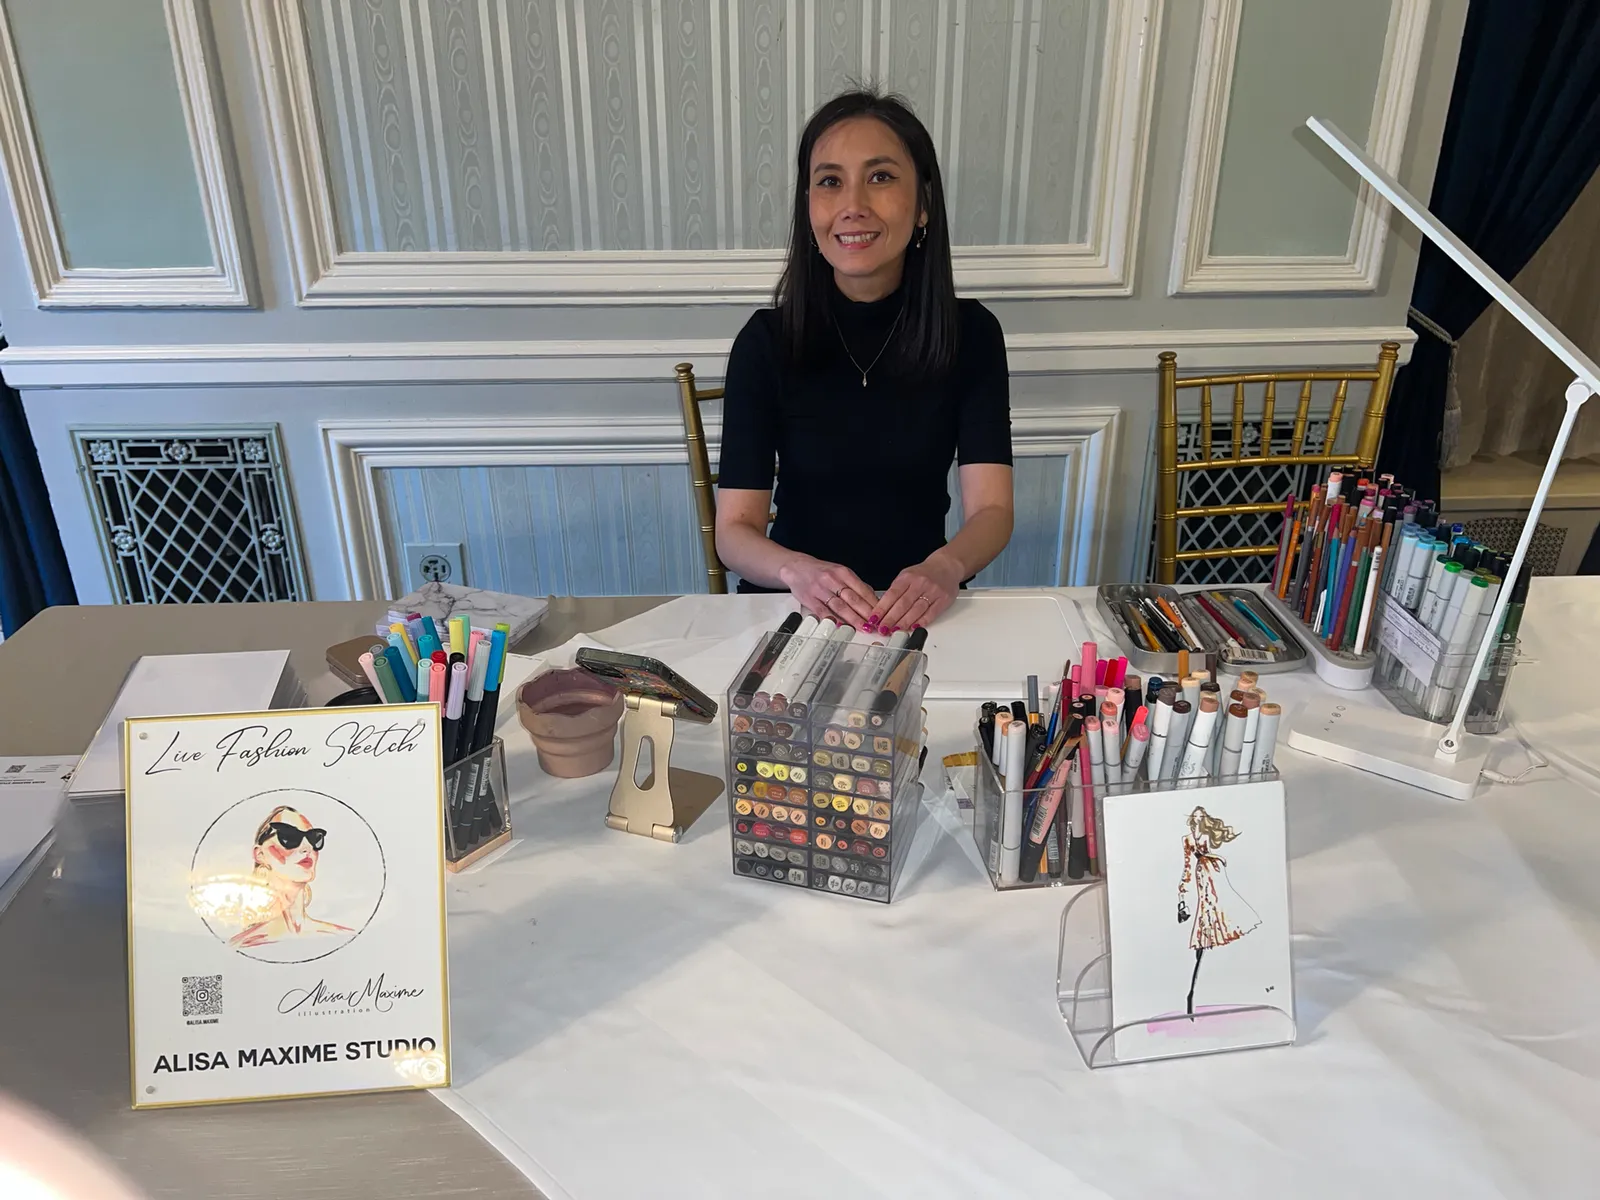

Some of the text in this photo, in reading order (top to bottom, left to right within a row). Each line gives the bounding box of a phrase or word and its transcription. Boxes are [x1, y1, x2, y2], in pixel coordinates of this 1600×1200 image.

[145, 721, 427, 775] Live Fashion Sketch
[277, 972, 425, 1014] Alisa Maxime
[153, 1051, 230, 1074] ALISA
[238, 1043, 338, 1068] MAXIME
